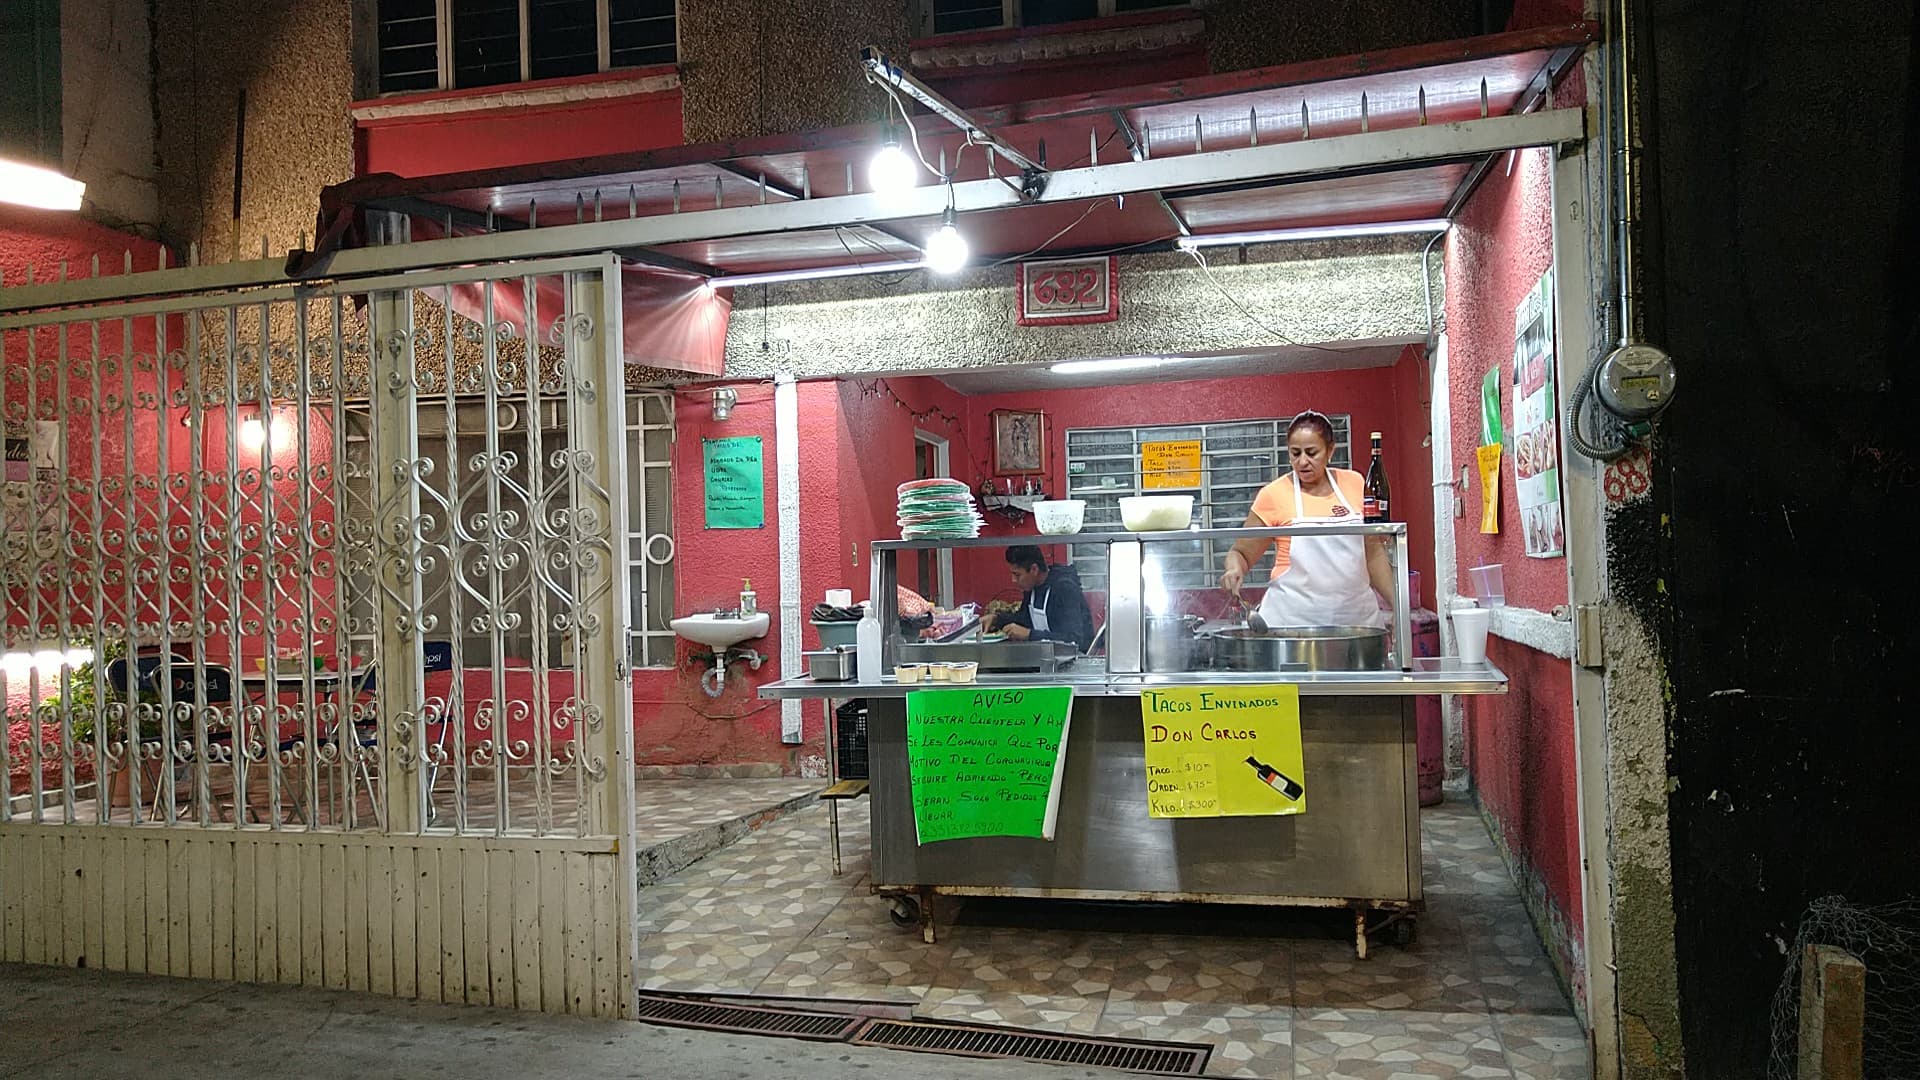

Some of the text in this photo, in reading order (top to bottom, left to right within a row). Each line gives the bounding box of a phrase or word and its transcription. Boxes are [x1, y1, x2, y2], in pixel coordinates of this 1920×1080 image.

[1033, 268, 1099, 305] 682
[973, 691, 1024, 708] AVISO
[1143, 692, 1279, 713] TACOS ENVINADOS
[915, 713, 964, 725] NUESTRA
[1032, 712, 1042, 726] Y
[1150, 722, 1257, 743] DON CARLOS
[1007, 734, 1033, 749] QUE
[1036, 736, 1059, 753] POR
[949, 753, 977, 766] DEL
